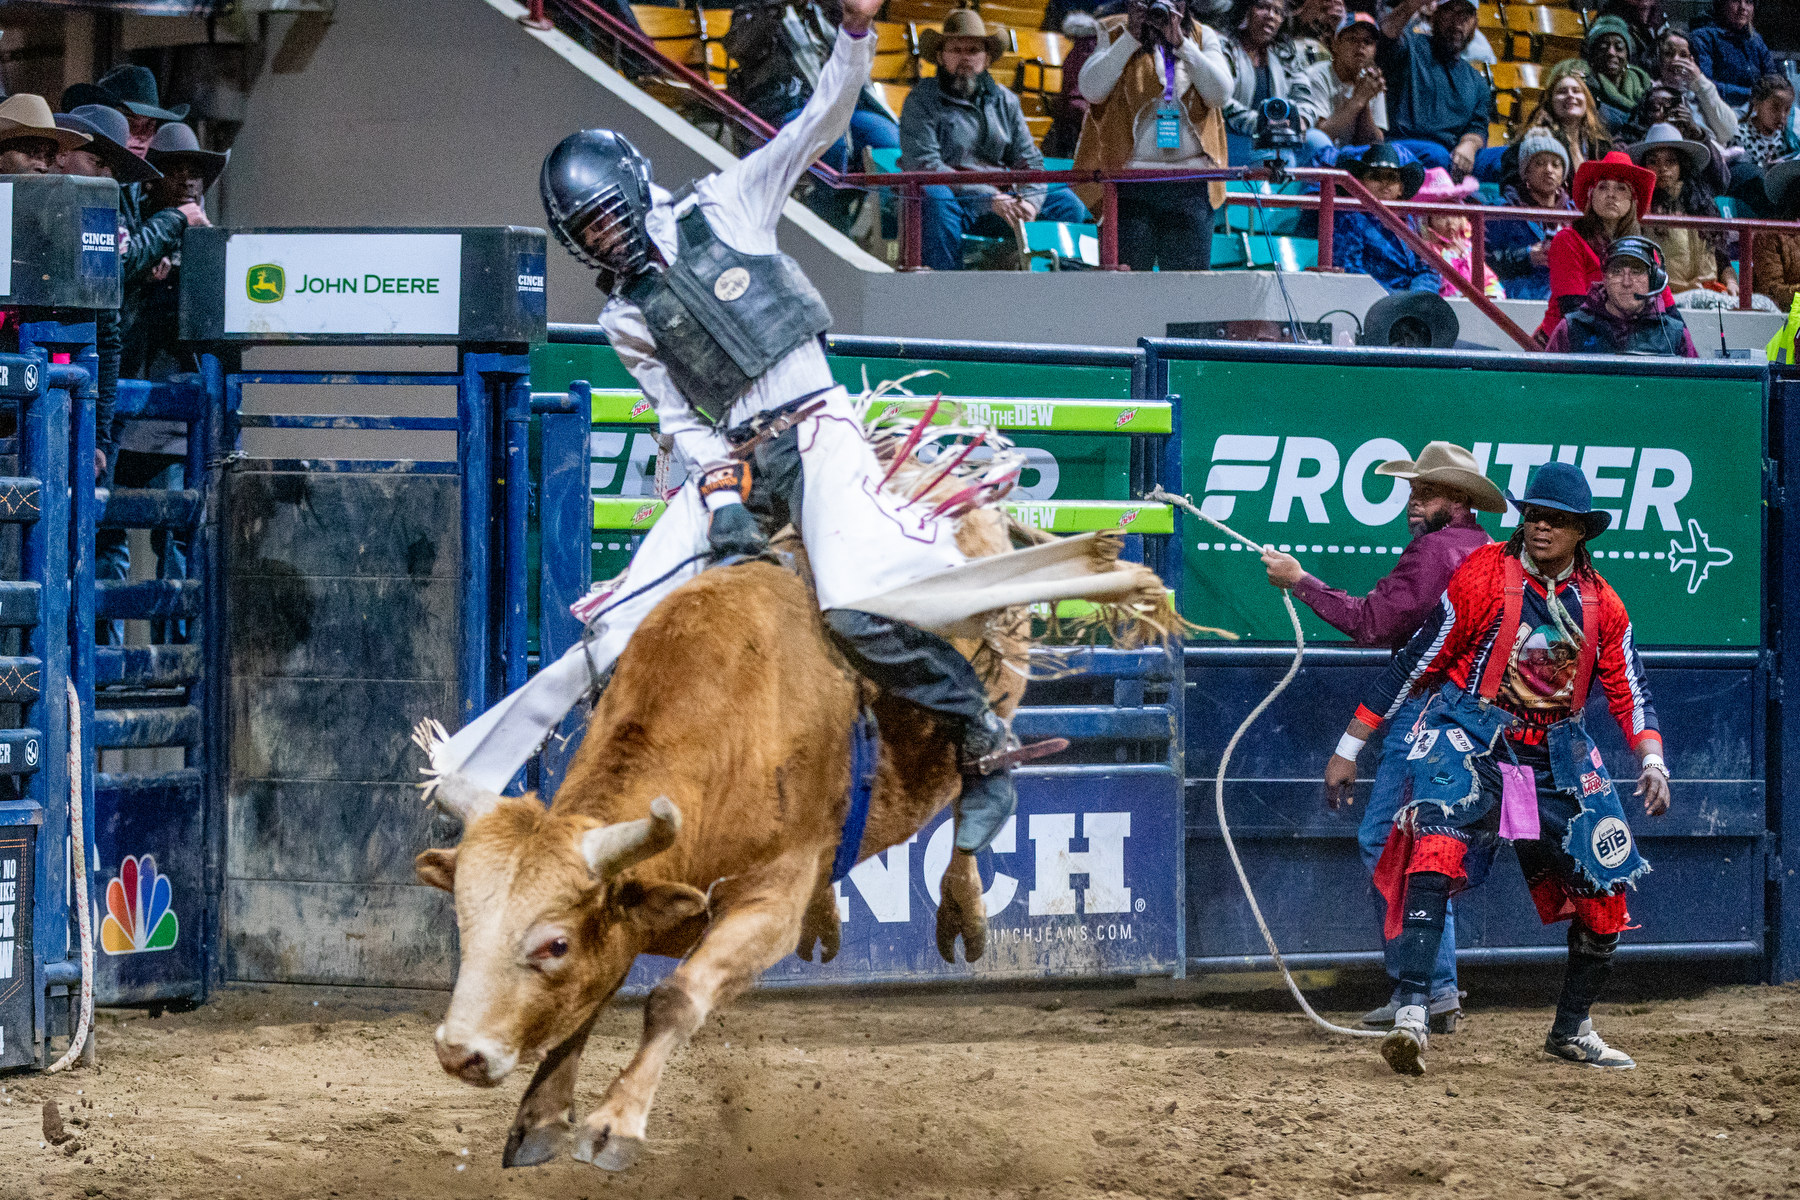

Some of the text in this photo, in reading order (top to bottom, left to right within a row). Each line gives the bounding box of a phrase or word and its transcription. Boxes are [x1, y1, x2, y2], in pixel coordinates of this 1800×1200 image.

[82, 232, 115, 245] CINCH
[295, 274, 440, 293] JOHN DEERE
[518, 274, 544, 287] CINCH
[1200, 434, 1693, 531] FROTER
[1596, 829, 1628, 859] BTB
[2, 859, 16, 880] NO
[835, 812, 1131, 923] NCH
